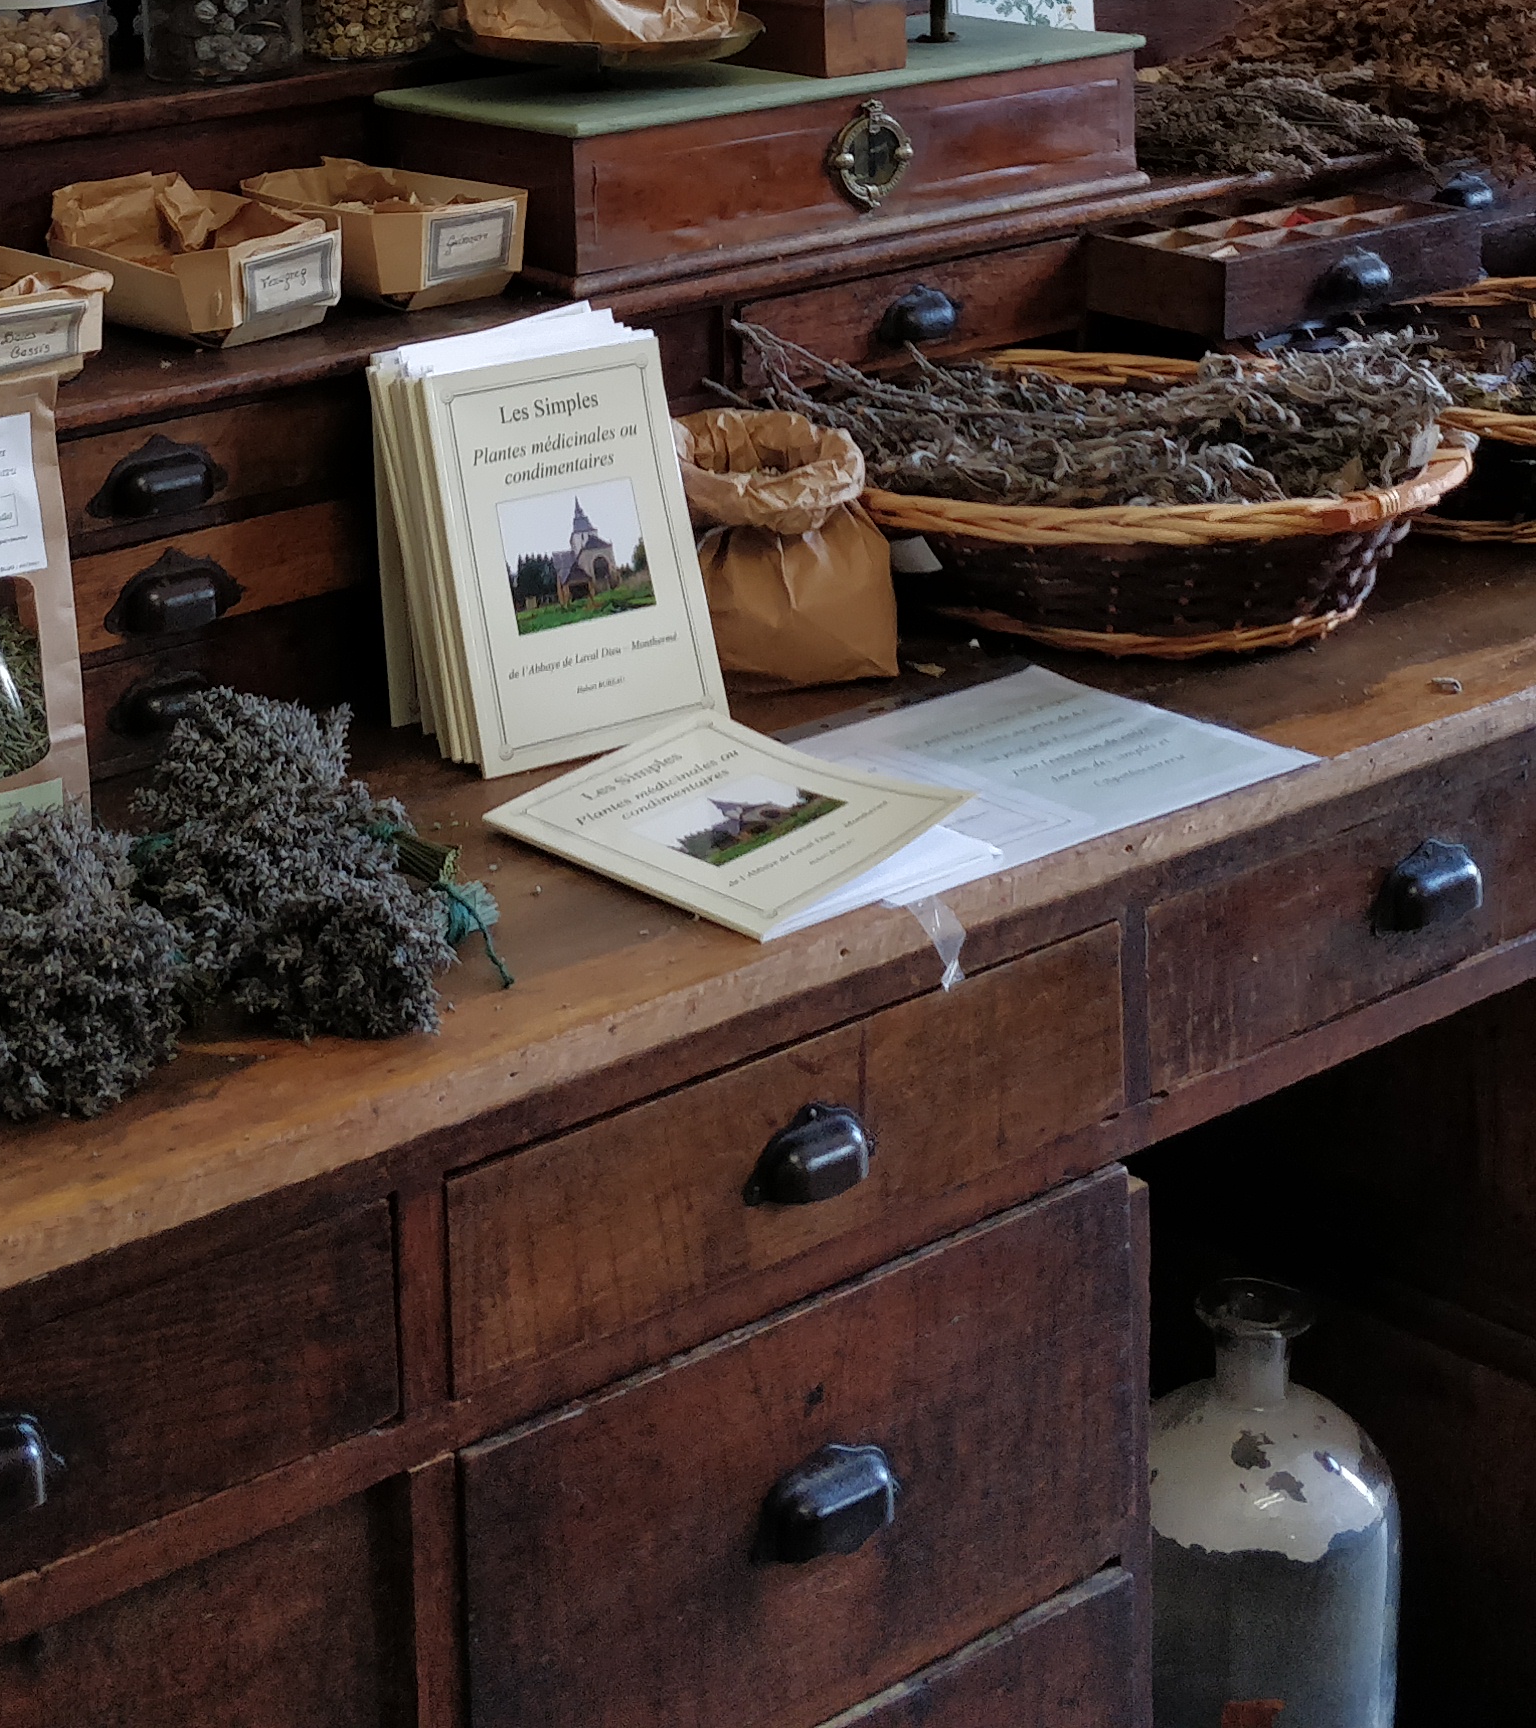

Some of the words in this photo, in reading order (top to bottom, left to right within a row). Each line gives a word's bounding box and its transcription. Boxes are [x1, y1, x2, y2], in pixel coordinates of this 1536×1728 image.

[499, 405, 529, 424] Les
[533, 392, 599, 418] Simples
[473, 445, 526, 466] Plantes
[531, 426, 615, 454] médicinales
[620, 424, 637, 436] ou
[505, 453, 614, 485] condimentaires
[509, 669, 519, 680] de
[522, 661, 560, 677] l'Abbaye
[563, 656, 572, 667] de
[576, 649, 598, 664] Laval
[602, 647, 621, 658] Dieu
[631, 631, 677, 650] Monthermé
[576, 795, 631, 826] Plantes
[634, 759, 718, 801] médicinales
[720, 749, 740, 762] ou
[581, 777, 616, 801] Les
[614, 752, 683, 789] Simples
[621, 769, 730, 821] condimentaires
